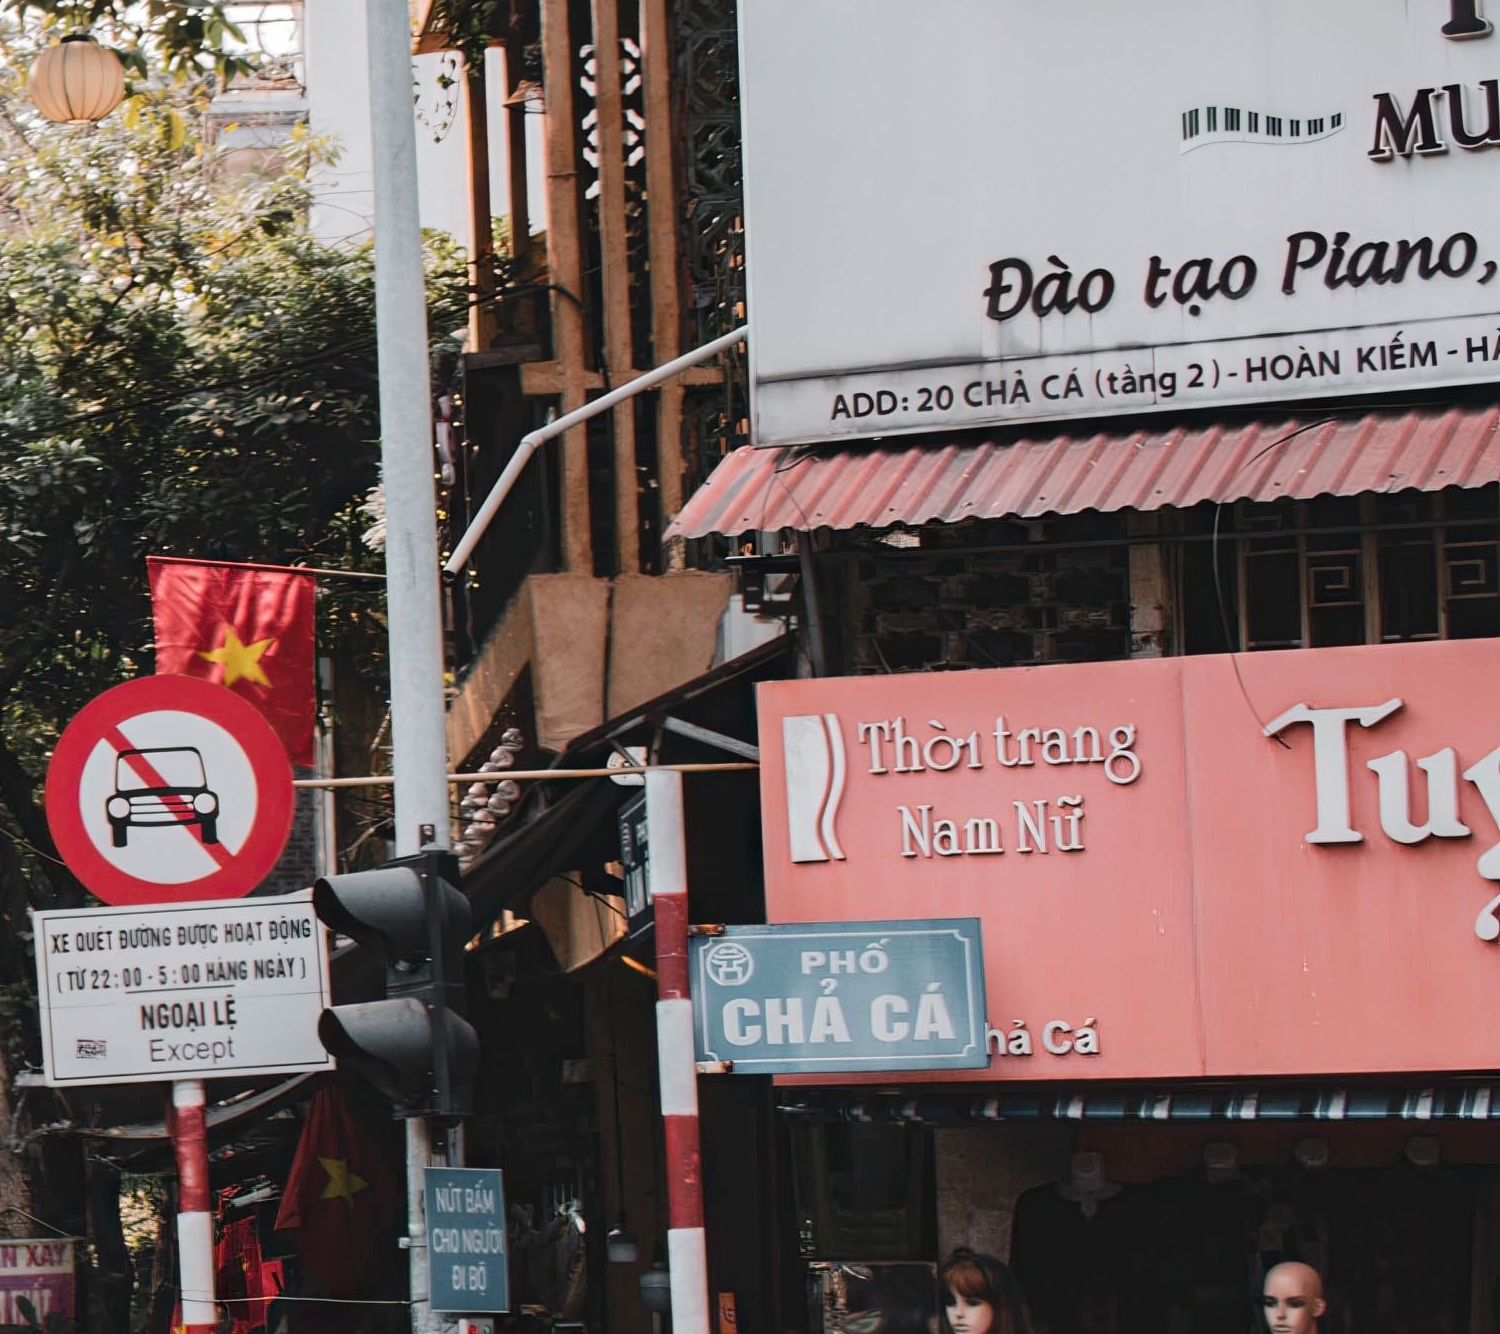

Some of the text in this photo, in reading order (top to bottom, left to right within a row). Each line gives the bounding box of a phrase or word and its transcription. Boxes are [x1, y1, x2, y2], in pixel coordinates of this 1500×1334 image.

[983, 231, 1498, 322] Đào tạo Piano,
[830, 388, 909, 421] ADD:
[916, 385, 954, 412] 20
[963, 369, 1029, 408] CHẢ
[1042, 367, 1083, 401] CÁ
[1246, 348, 1341, 384] HOÀN
[1356, 331, 1437, 372] KIẾM
[858, 715, 1142, 785] Thời trang
[897, 794, 1087, 859] Nam Nữ
[50, 933, 69, 954] XE
[224, 921, 264, 947] HOẠT
[269, 916, 312, 945] ĐỘNG
[206, 954, 248, 983] HÀNG
[254, 952, 296, 980] NGÀY
[801, 938, 891, 975] PHỐ
[140, 994, 237, 1033] NGOẠI LỆ
[722, 977, 957, 1047] CHẢ CÁ
[149, 1037, 235, 1064] Except
[1042, 1017, 1102, 1057] Cá
[435, 1179, 496, 1215] NÚT BẤM
[432, 1228, 459, 1254] CHO
[452, 1265, 467, 1291] ĐI
